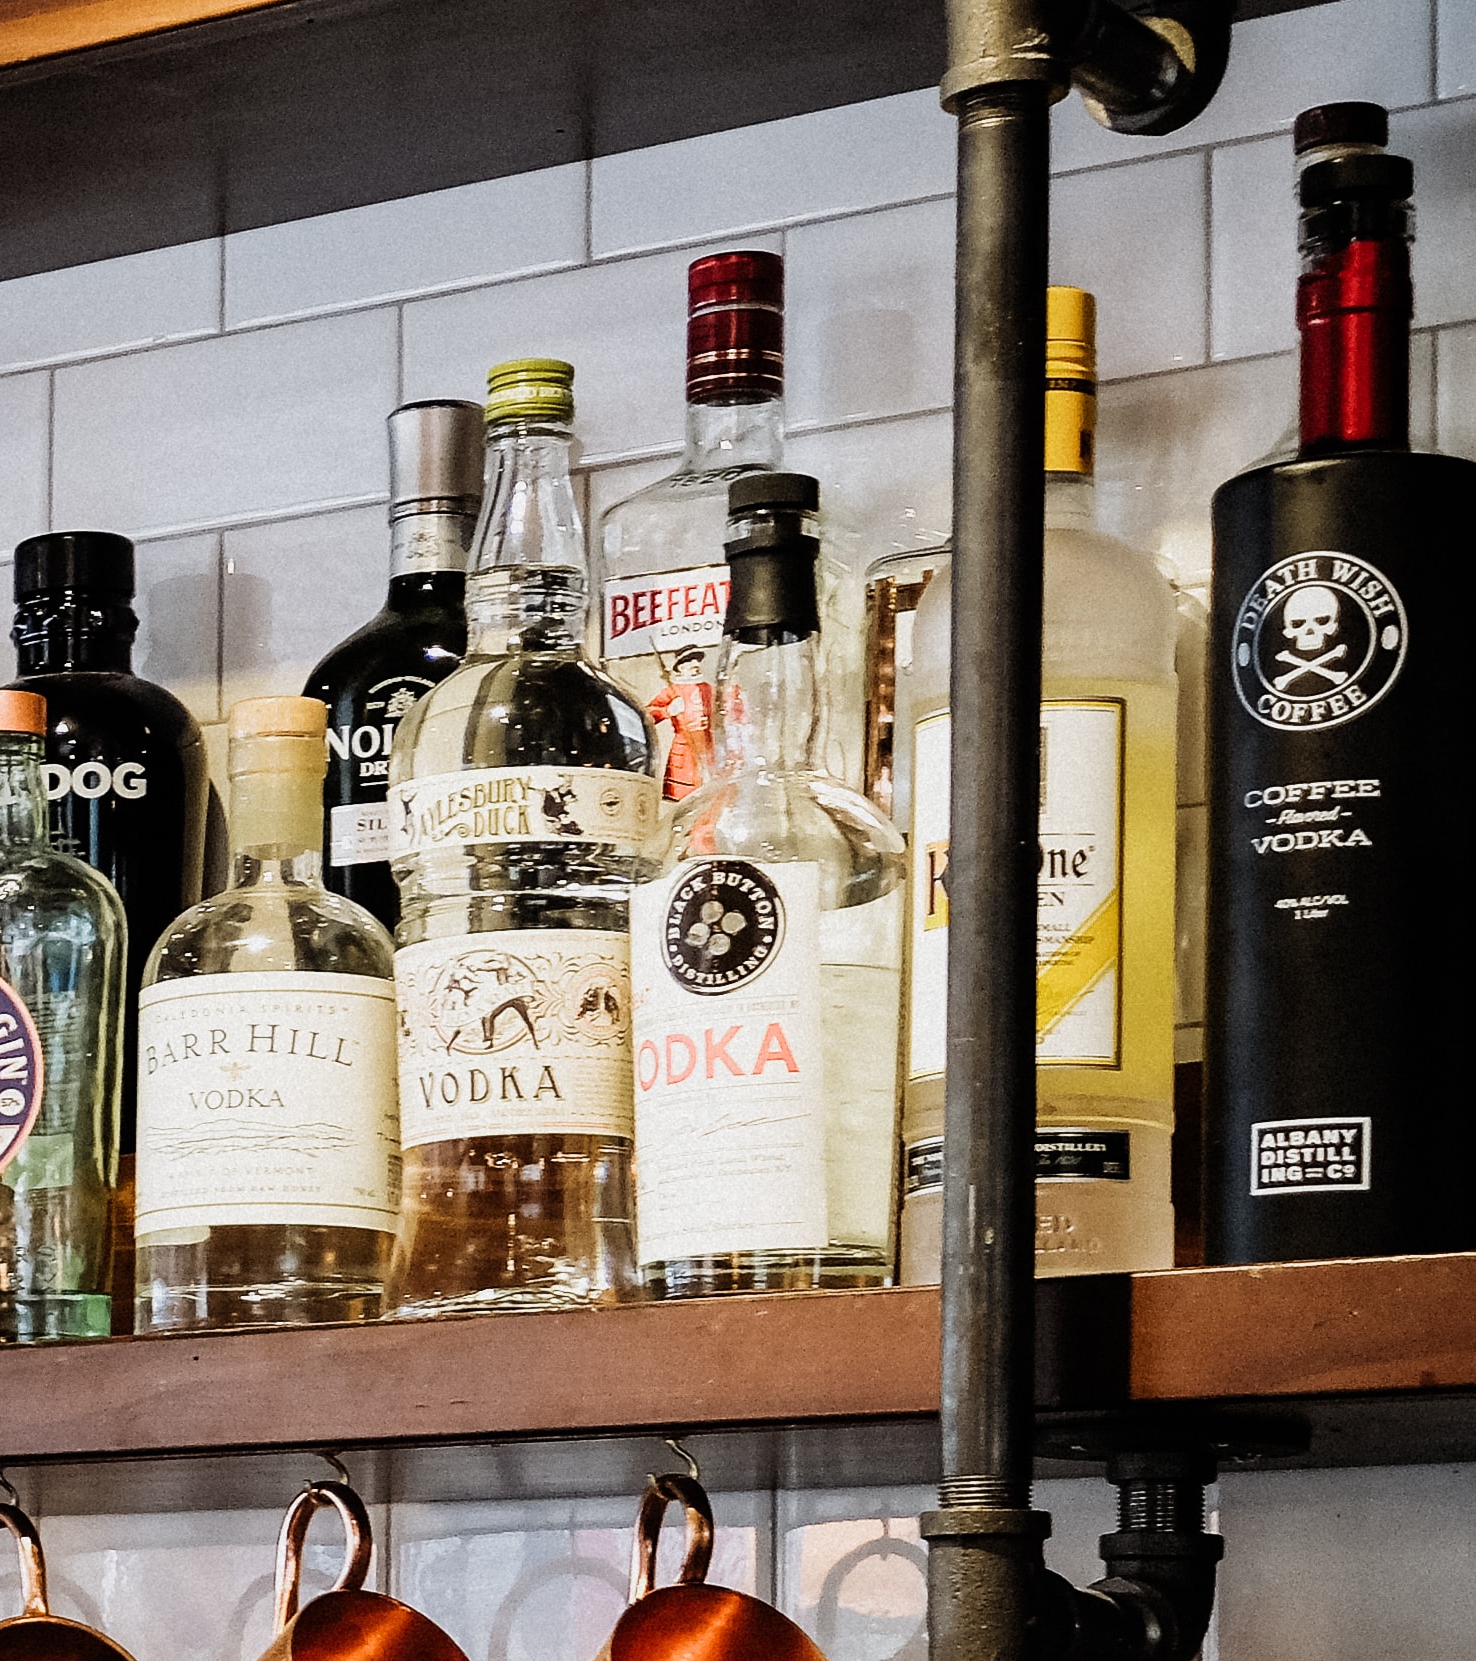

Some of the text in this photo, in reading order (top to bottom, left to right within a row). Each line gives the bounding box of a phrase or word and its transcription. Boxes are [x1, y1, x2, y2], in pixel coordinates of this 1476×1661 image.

[1240, 558, 1320, 632] DEATH
[1330, 558, 1396, 620] WISH
[1256, 684, 1369, 725] COFFEE
[1242, 779, 1383, 809] COFFEE
[473, 804, 531, 838] DUCK
[1250, 828, 1374, 855] VODKA
[667, 876, 707, 940] BLACK
[710, 871, 777, 932] BUTTON
[671, 944, 769, 986] DISTILLING
[145, 1022, 354, 1076] BARR HILL
[638, 1021, 802, 1093] ODKA
[187, 1088, 286, 1111] VODKA
[418, 1064, 567, 1110] VODKA
[1259, 1128, 1358, 1149] ALBANY
[1260, 1146, 1357, 1167] DISTILL
